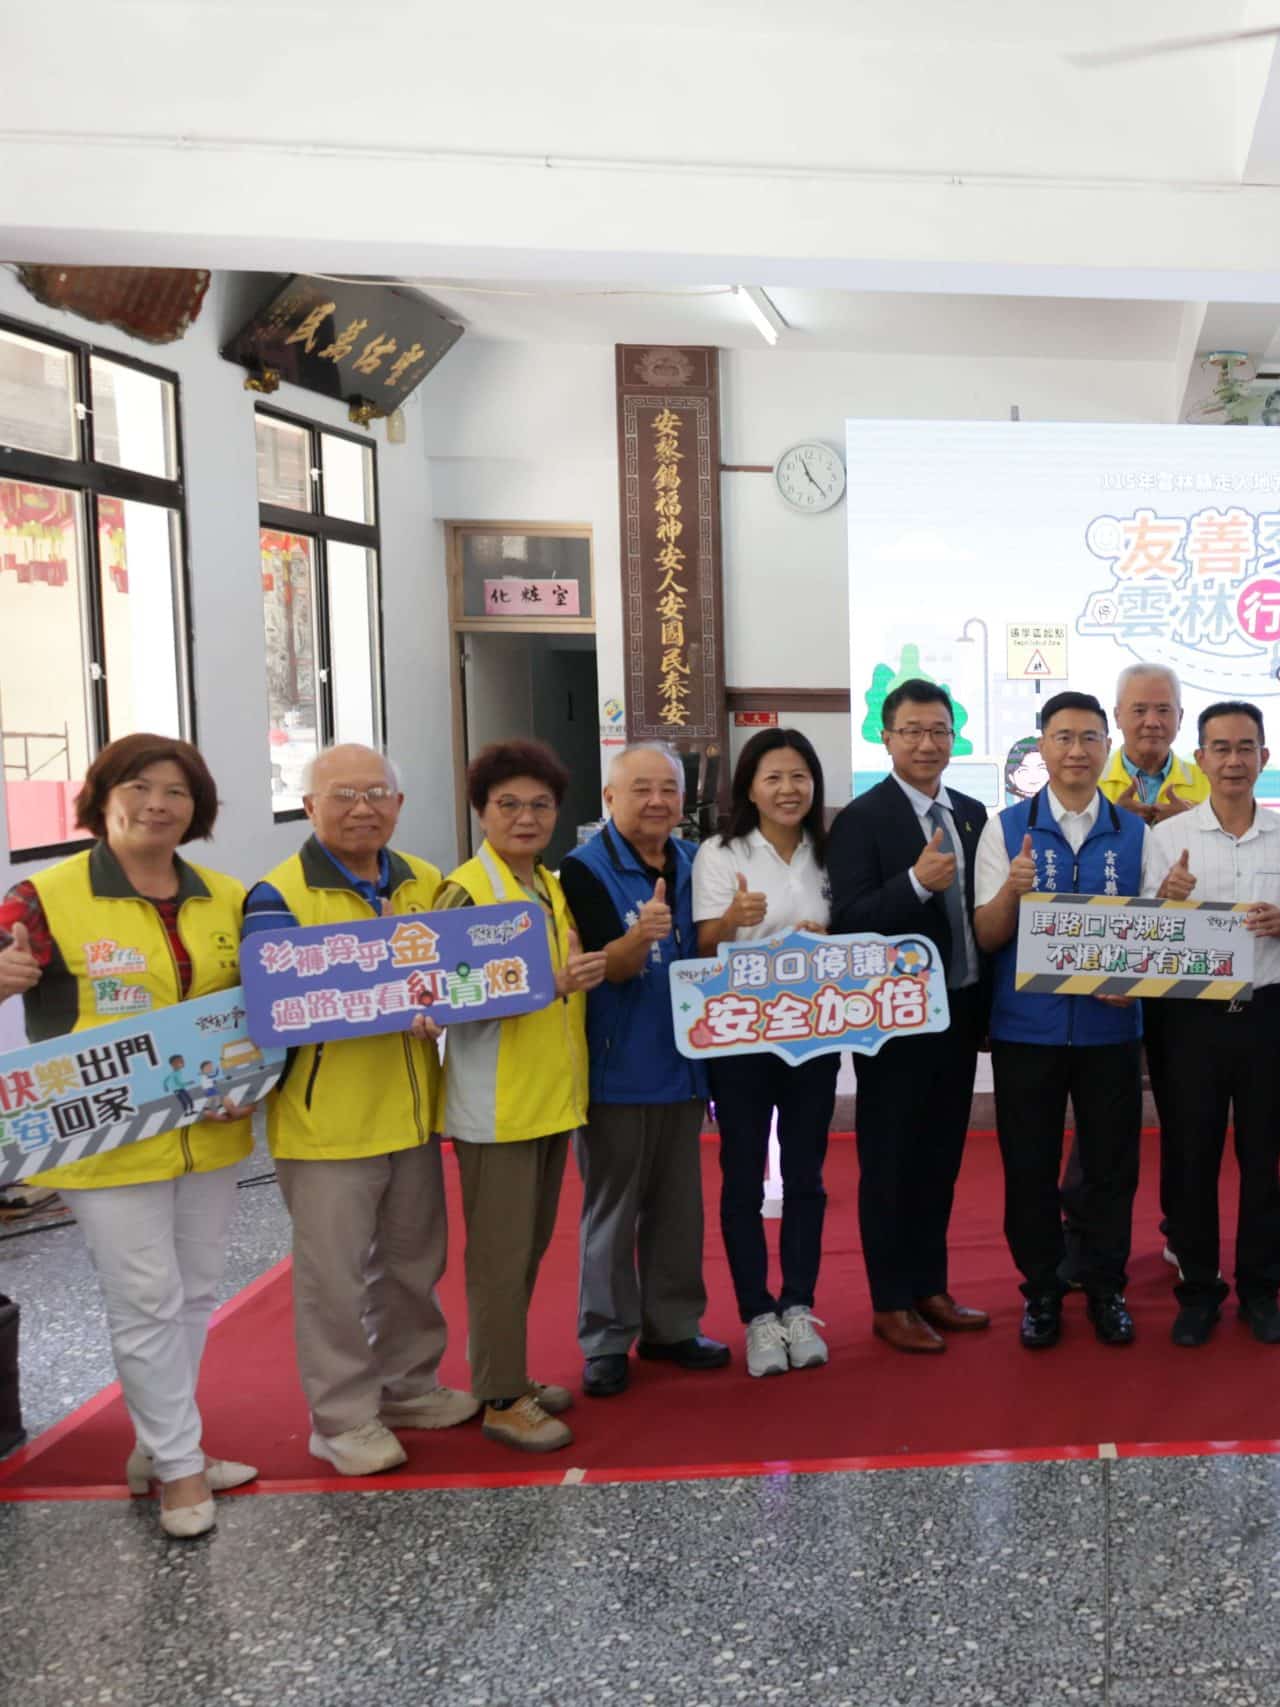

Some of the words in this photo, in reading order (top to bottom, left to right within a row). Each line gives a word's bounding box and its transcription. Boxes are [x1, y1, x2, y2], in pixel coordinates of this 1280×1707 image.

[731, 943, 889, 988] 路口停讓
[1047, 944, 1234, 977] 不搶快才有福氣
[704, 979, 926, 1044] 安全加倍
